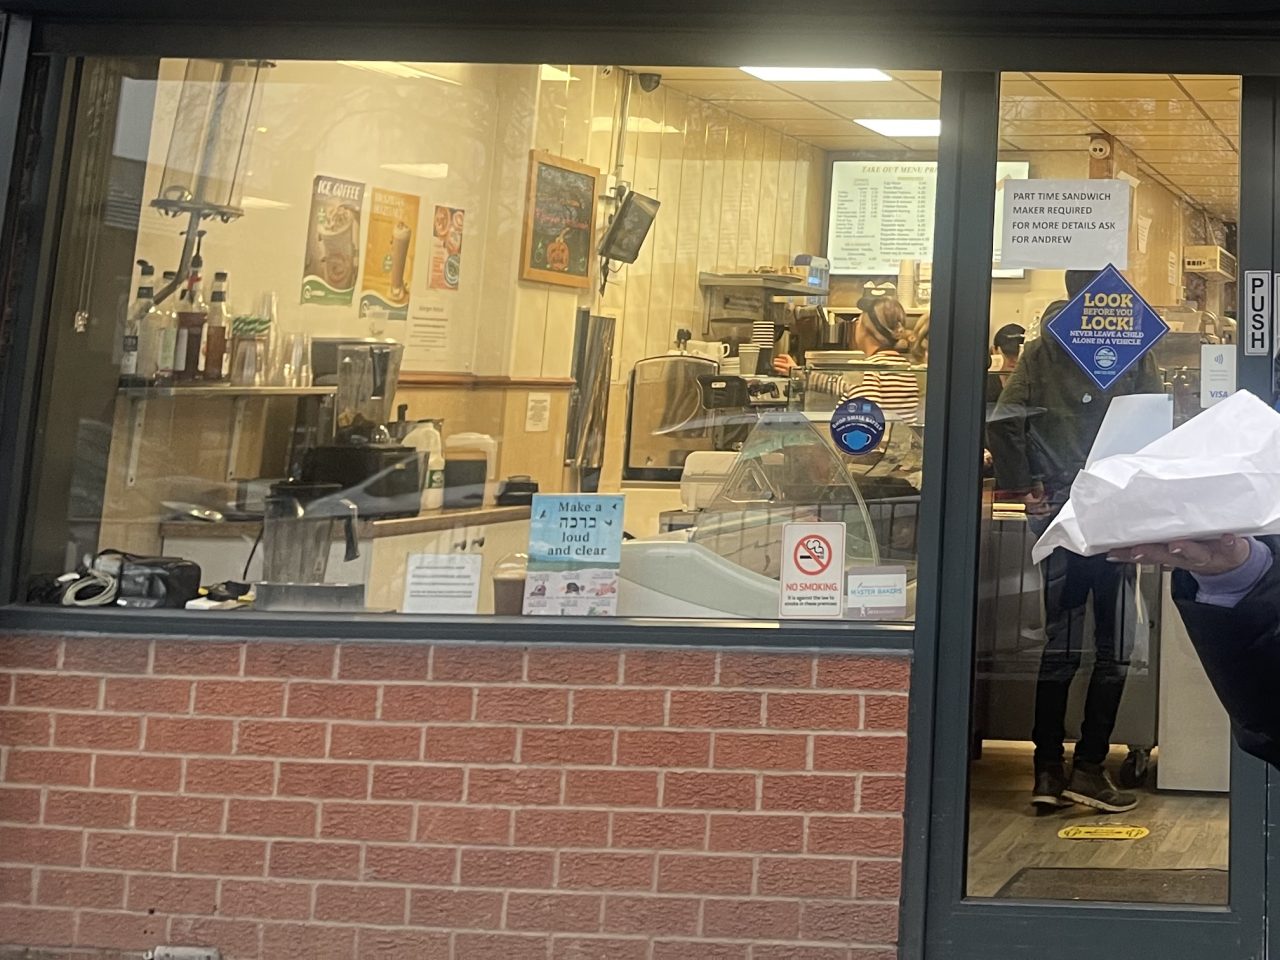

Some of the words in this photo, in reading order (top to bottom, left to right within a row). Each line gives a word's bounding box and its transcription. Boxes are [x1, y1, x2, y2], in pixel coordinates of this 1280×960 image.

[317, 179, 332, 195] ICE
[332, 182, 361, 201] COFFEE
[1013, 192, 1035, 200] PART
[1038, 192, 1059, 200] TIME
[1061, 192, 1111, 201] SANDWICH
[1012, 206, 1045, 215] MAKER
[1047, 206, 1092, 215] REQUIRED
[1012, 221, 1030, 229] FOR
[1032, 221, 1059, 229] MORE
[1061, 221, 1096, 230] DETAILS
[1098, 222, 1116, 230] ASK
[1012, 235, 1029, 243] FOR
[1031, 235, 1072, 244] ANDREW
[1084, 293, 1134, 308] LOOK
[1083, 308, 1115, 316] BEFORE
[1115, 308, 1133, 316] YOU
[1251, 278, 1265, 349] PUSH
[1081, 316, 1134, 331] LOCK!
[559, 502, 591, 512] Make
[595, 504, 602, 512] a
[560, 517, 597, 528] ברכה
[562, 531, 590, 543] loud
[547, 545, 571, 556] and
[575, 545, 607, 556] clear
[785, 583, 798, 591] NO
